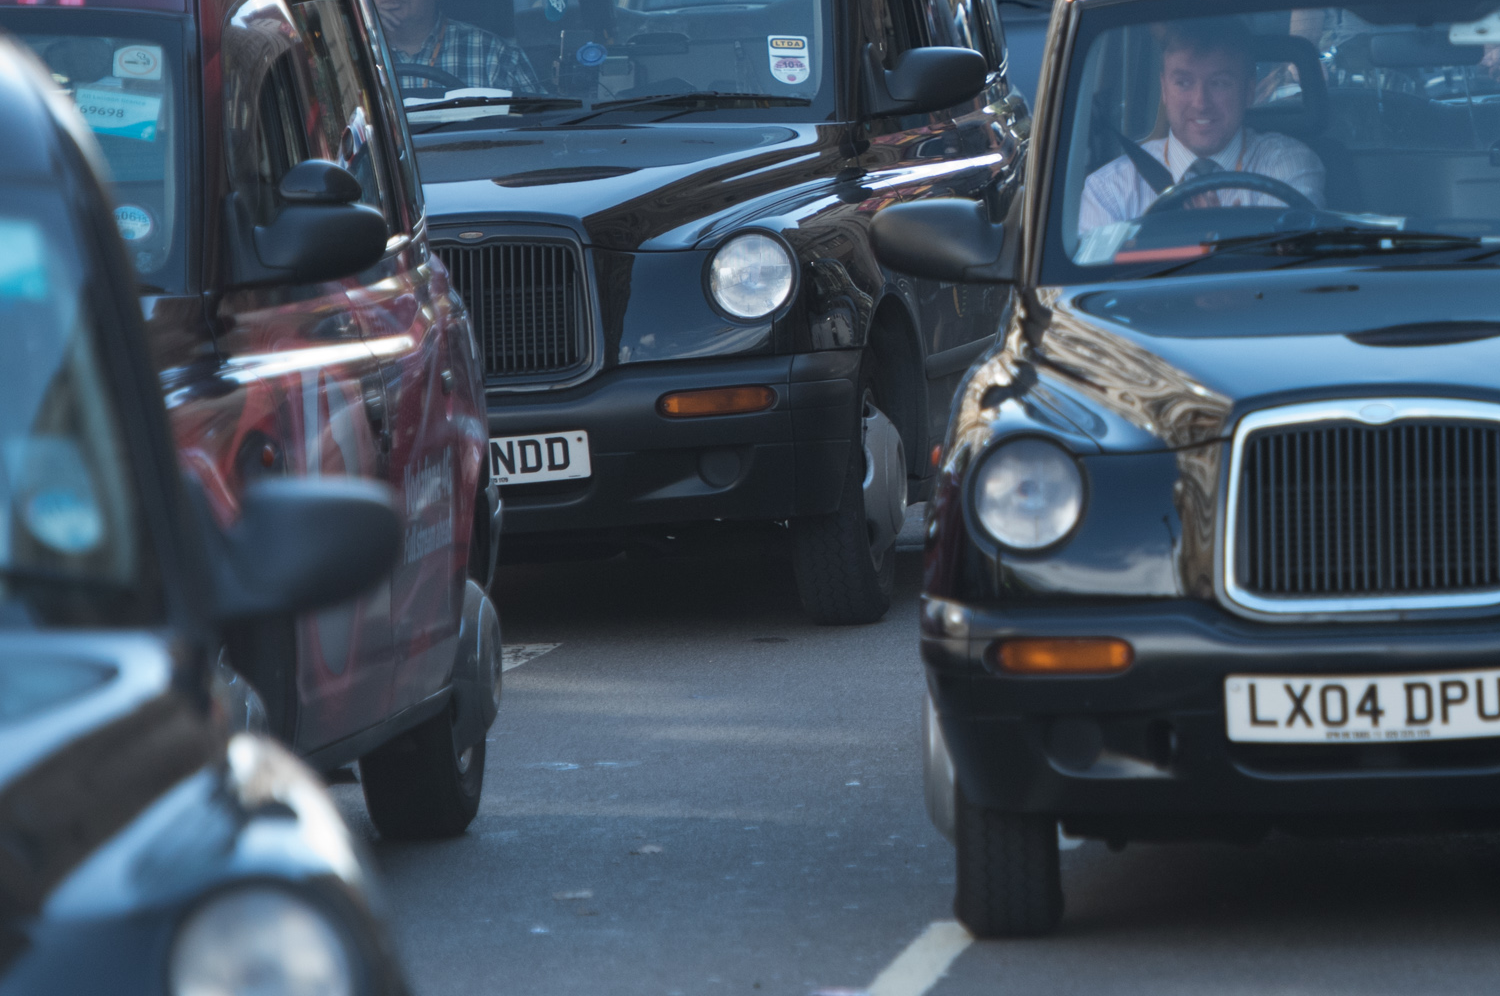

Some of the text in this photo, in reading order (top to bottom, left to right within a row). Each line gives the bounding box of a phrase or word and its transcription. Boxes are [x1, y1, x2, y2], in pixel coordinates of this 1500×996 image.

[80, 105, 124, 118] 69698
[490, 436, 570, 476] NDD
[1248, 683, 1384, 728] LX04
